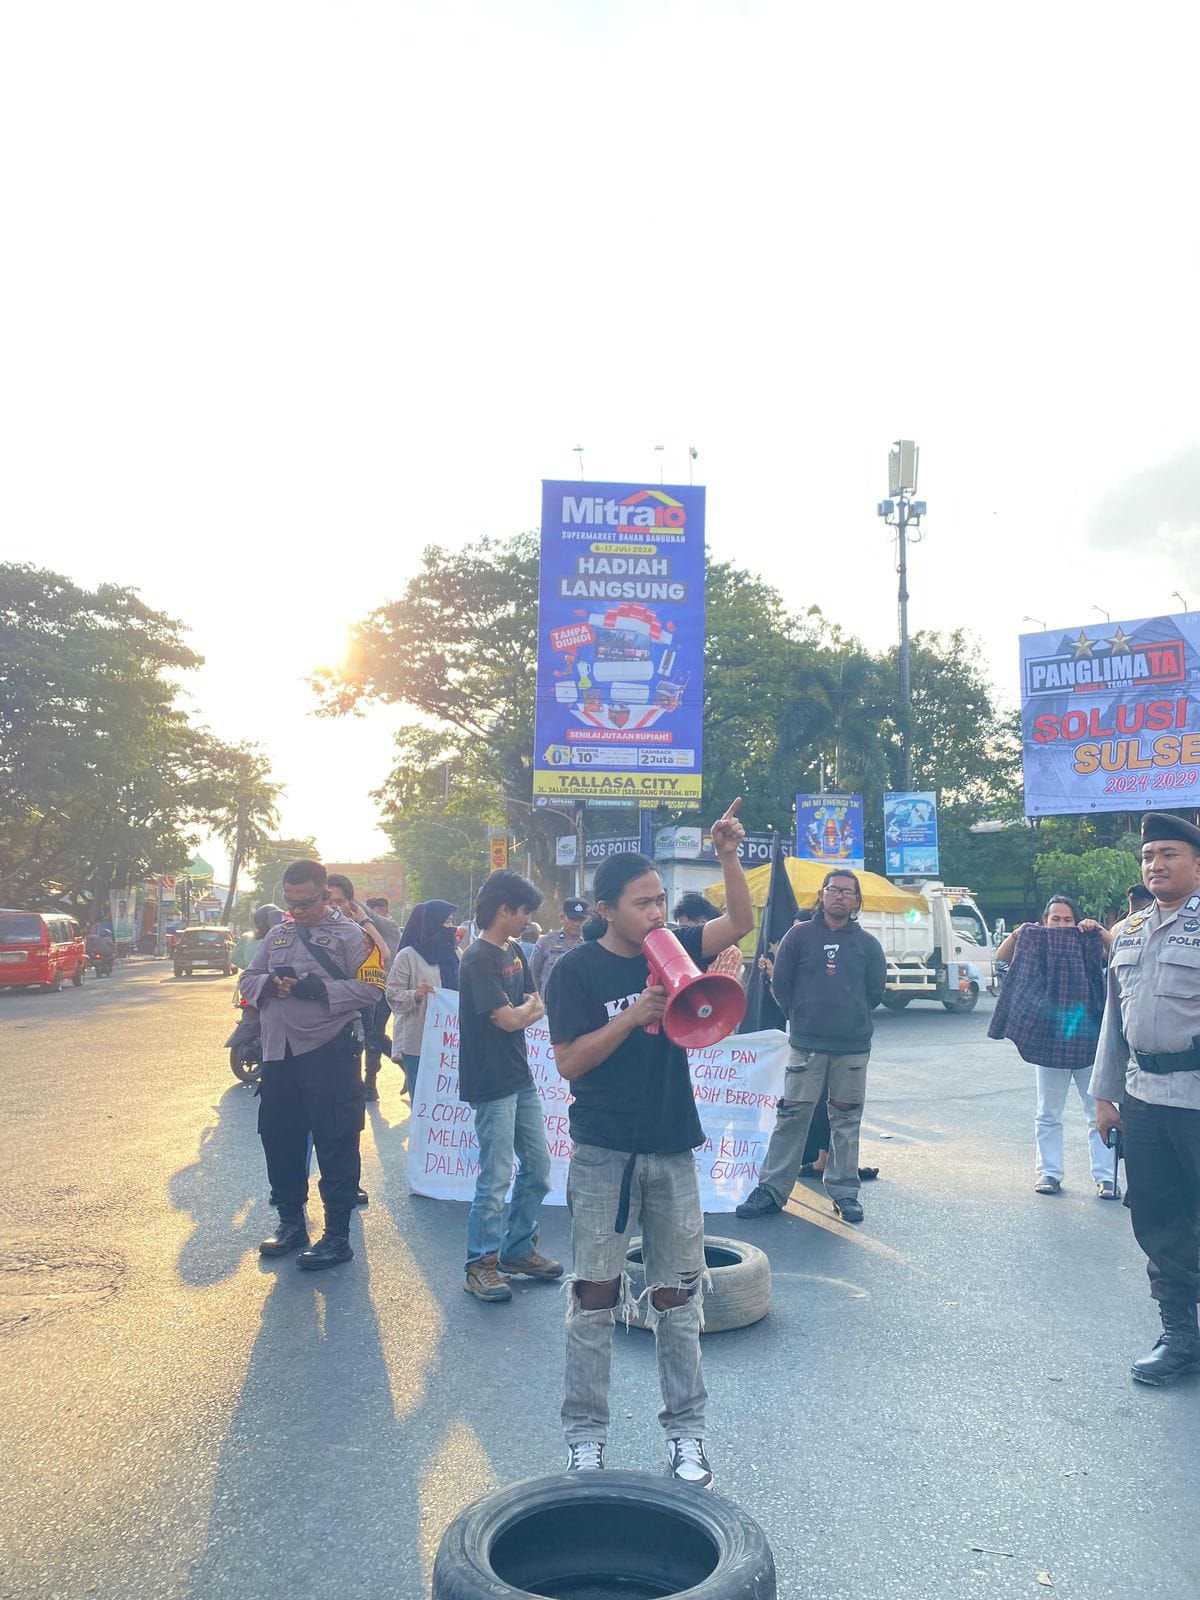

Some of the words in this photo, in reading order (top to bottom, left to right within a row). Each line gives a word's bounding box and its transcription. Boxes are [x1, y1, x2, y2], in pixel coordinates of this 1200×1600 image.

[562, 496, 686, 528] Mitra10
[561, 531, 616, 541] SUPERMARKET
[579, 557, 668, 575] HADIAH
[561, 579, 685, 600] LANGSUNG
[552, 625, 589, 640] TANPA
[555, 633, 592, 649] DIUNDI
[1107, 680, 1133, 688] TEGAS
[1033, 698, 1187, 744] SOLUSI
[570, 731, 601, 739] SENILAI
[602, 732, 635, 740] JUTAAN
[636, 733, 669, 741] RUPIAH!
[641, 755, 650, 765] 2
[650, 755, 674, 764] Juta
[558, 776, 637, 789] TALLASA
[641, 778, 679, 790] CITY
[823, 799, 848, 807] ENERGI
[585, 844, 606, 857] POS
[608, 841, 641, 856] POLISI
[732, 1050, 757, 1064] DAN
[694, 1064, 742, 1082] CATUR
[691, 1084, 721, 1103] ASIH
[720, 1136, 763, 1157] KUAT
[425, 1152, 481, 1178] DALAM
